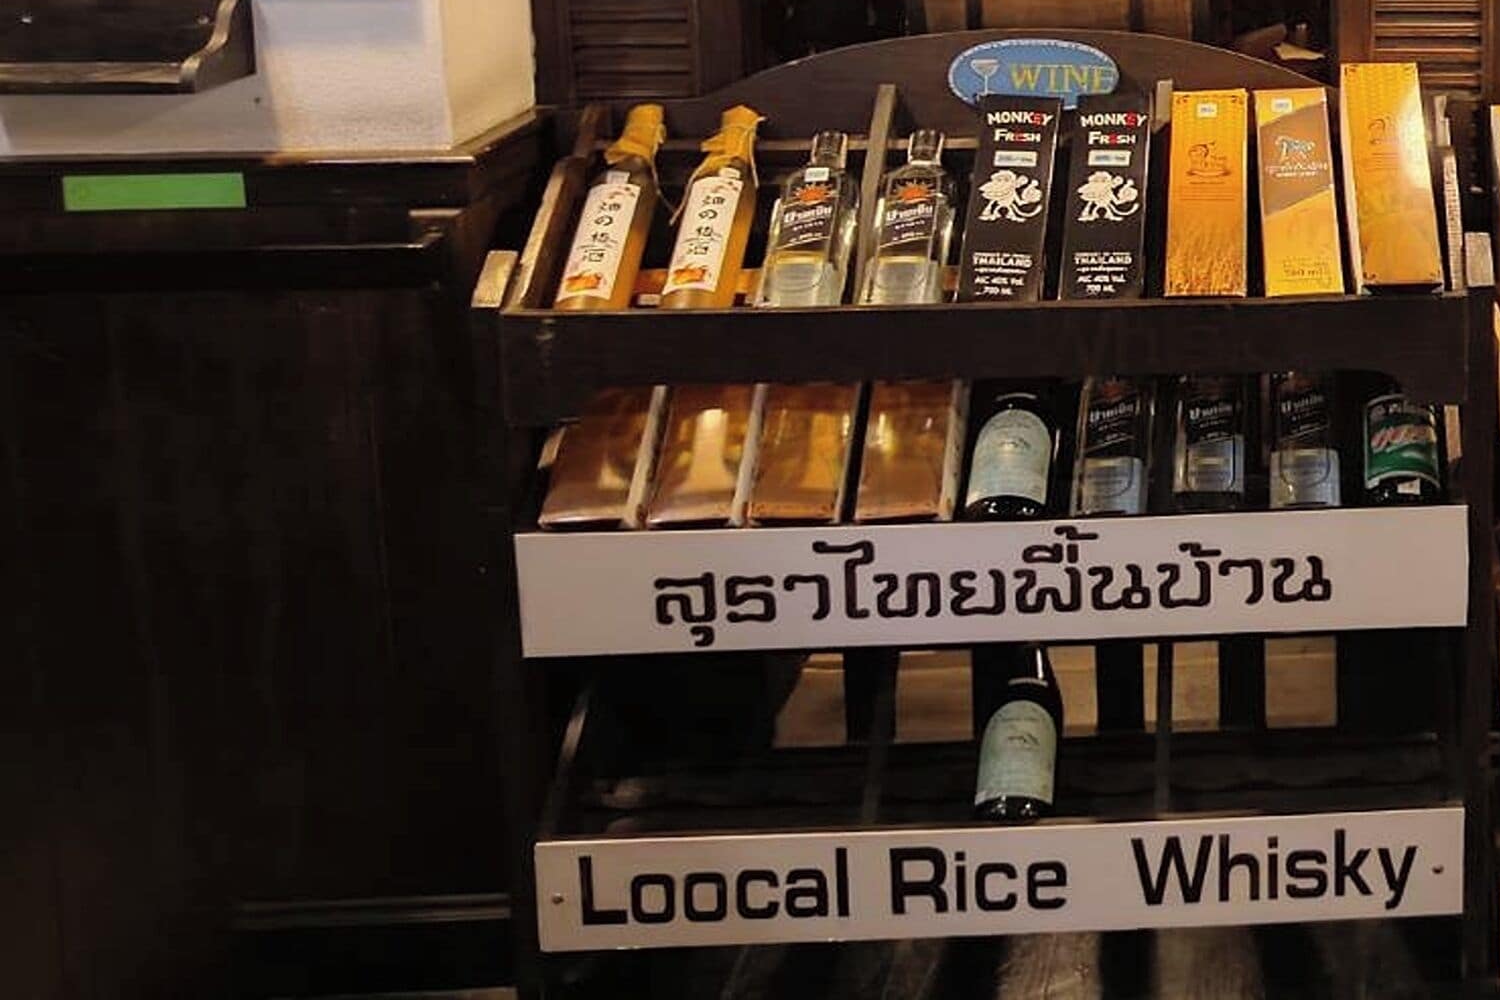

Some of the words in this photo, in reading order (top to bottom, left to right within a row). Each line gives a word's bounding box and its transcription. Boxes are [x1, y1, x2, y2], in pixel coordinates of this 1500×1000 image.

[1008, 61, 1115, 93] WINE
[986, 111, 1055, 127] MONKEY
[1080, 113, 1147, 128] MONKEY
[993, 128, 1042, 143] FRESH
[1087, 131, 1137, 146] FRESH
[973, 256, 1033, 268] THAILAND
[1074, 256, 1133, 266] THAILAND
[653, 526, 1332, 647] สุราไทยพื้นบ้าน
[577, 846, 850, 926] Loocal
[888, 844, 1069, 916] Rice
[1130, 828, 1420, 910] Whisky
